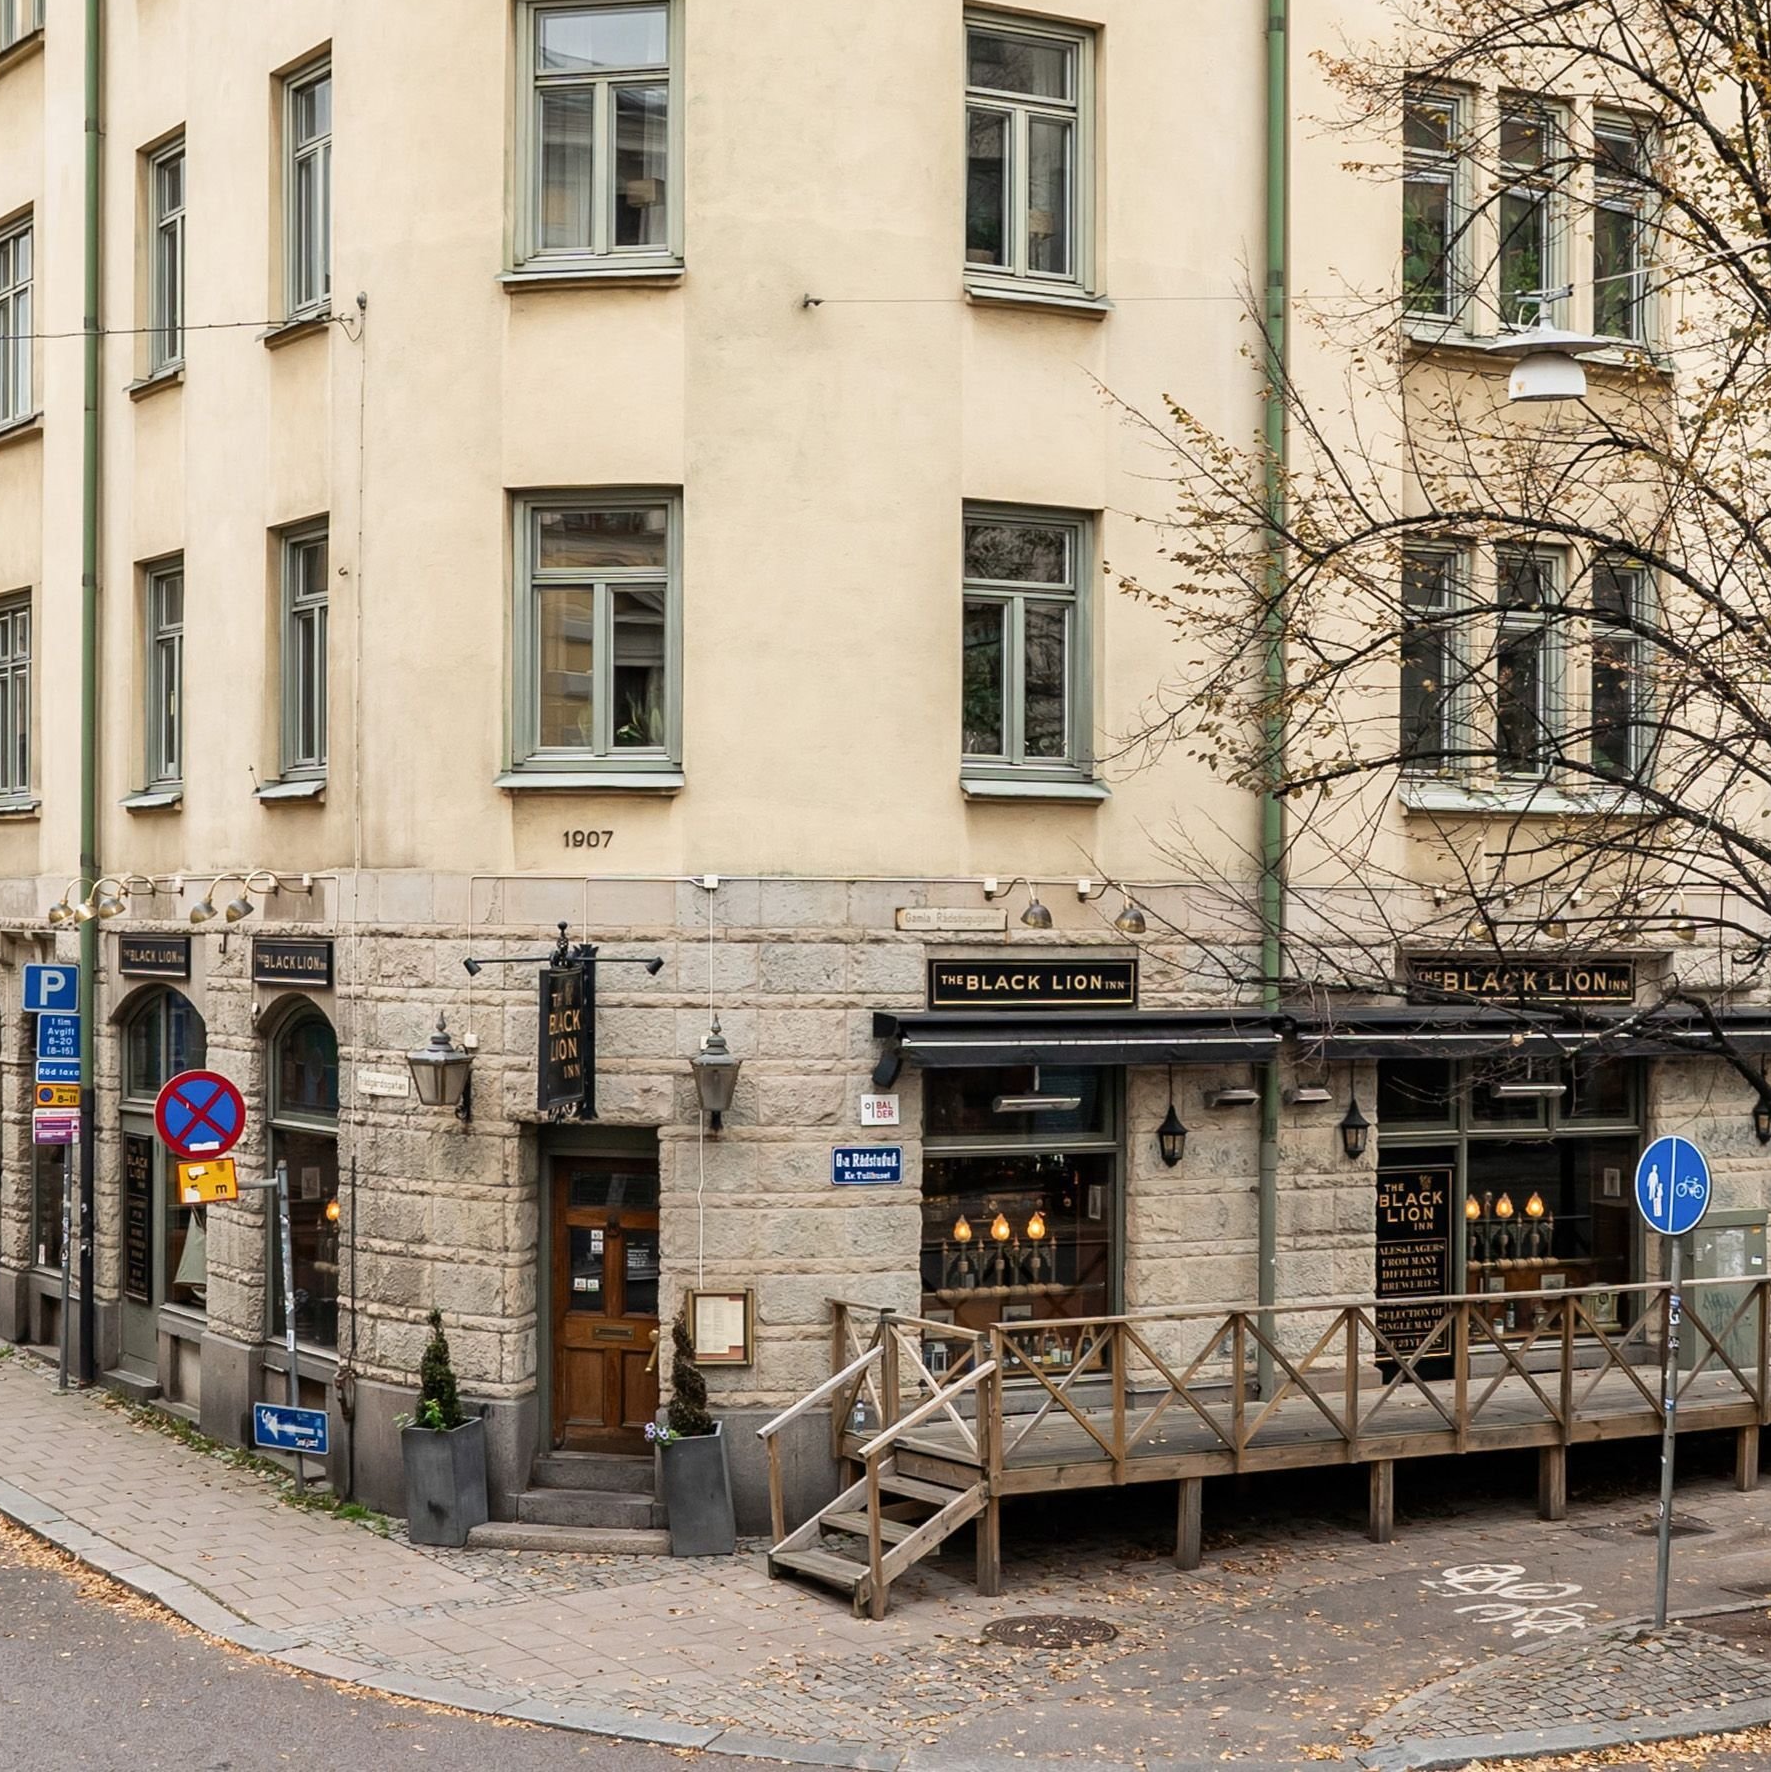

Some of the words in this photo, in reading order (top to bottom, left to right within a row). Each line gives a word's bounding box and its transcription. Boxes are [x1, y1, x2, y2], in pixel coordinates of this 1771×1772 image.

[563, 830, 614, 848] 1907
[905, 912, 931, 924] Gamla
[130, 949, 157, 963] BLACK
[159, 950, 178, 964] LION
[264, 954, 296, 969] BLACK
[297, 955, 320, 970] LION
[941, 975, 963, 986] THE
[966, 975, 1041, 991] BLACK
[1052, 975, 1102, 991] LION
[1105, 981, 1125, 990] INN
[1548, 971, 1607, 992] LION
[1608, 980, 1629, 991] INN
[39, 970, 66, 1006] P
[57, 1018, 72, 1026] tim
[548, 1009, 581, 1035] BLACK
[47, 1027, 75, 1037] Avgift
[48, 1037, 73, 1046] 8-20
[550, 1037, 578, 1062] LION
[39, 1067, 57, 1076] Röd
[59, 1068, 81, 1076] taxa
[563, 1064, 581, 1079] INN
[876, 1101, 893, 1110] BAL
[876, 1110, 895, 1119] DER
[215, 1184, 228, 1195] m
[1384, 1183, 1405, 1192] THE
[1379, 1191, 1443, 1207] BLACK
[1387, 1207, 1434, 1223] LION
[1414, 1222, 1434, 1231] INN
[1382, 1257, 1409, 1268] FROM
[1411, 1256, 1437, 1265] MANY
[1382, 1268, 1438, 1279] DIFFERENT
[1381, 1280, 1440, 1291] BREWERIES
[1378, 1309, 1430, 1321] SELECTION
[1431, 1308, 1443, 1316] OF
[1378, 1322, 1413, 1332] SINGLE
